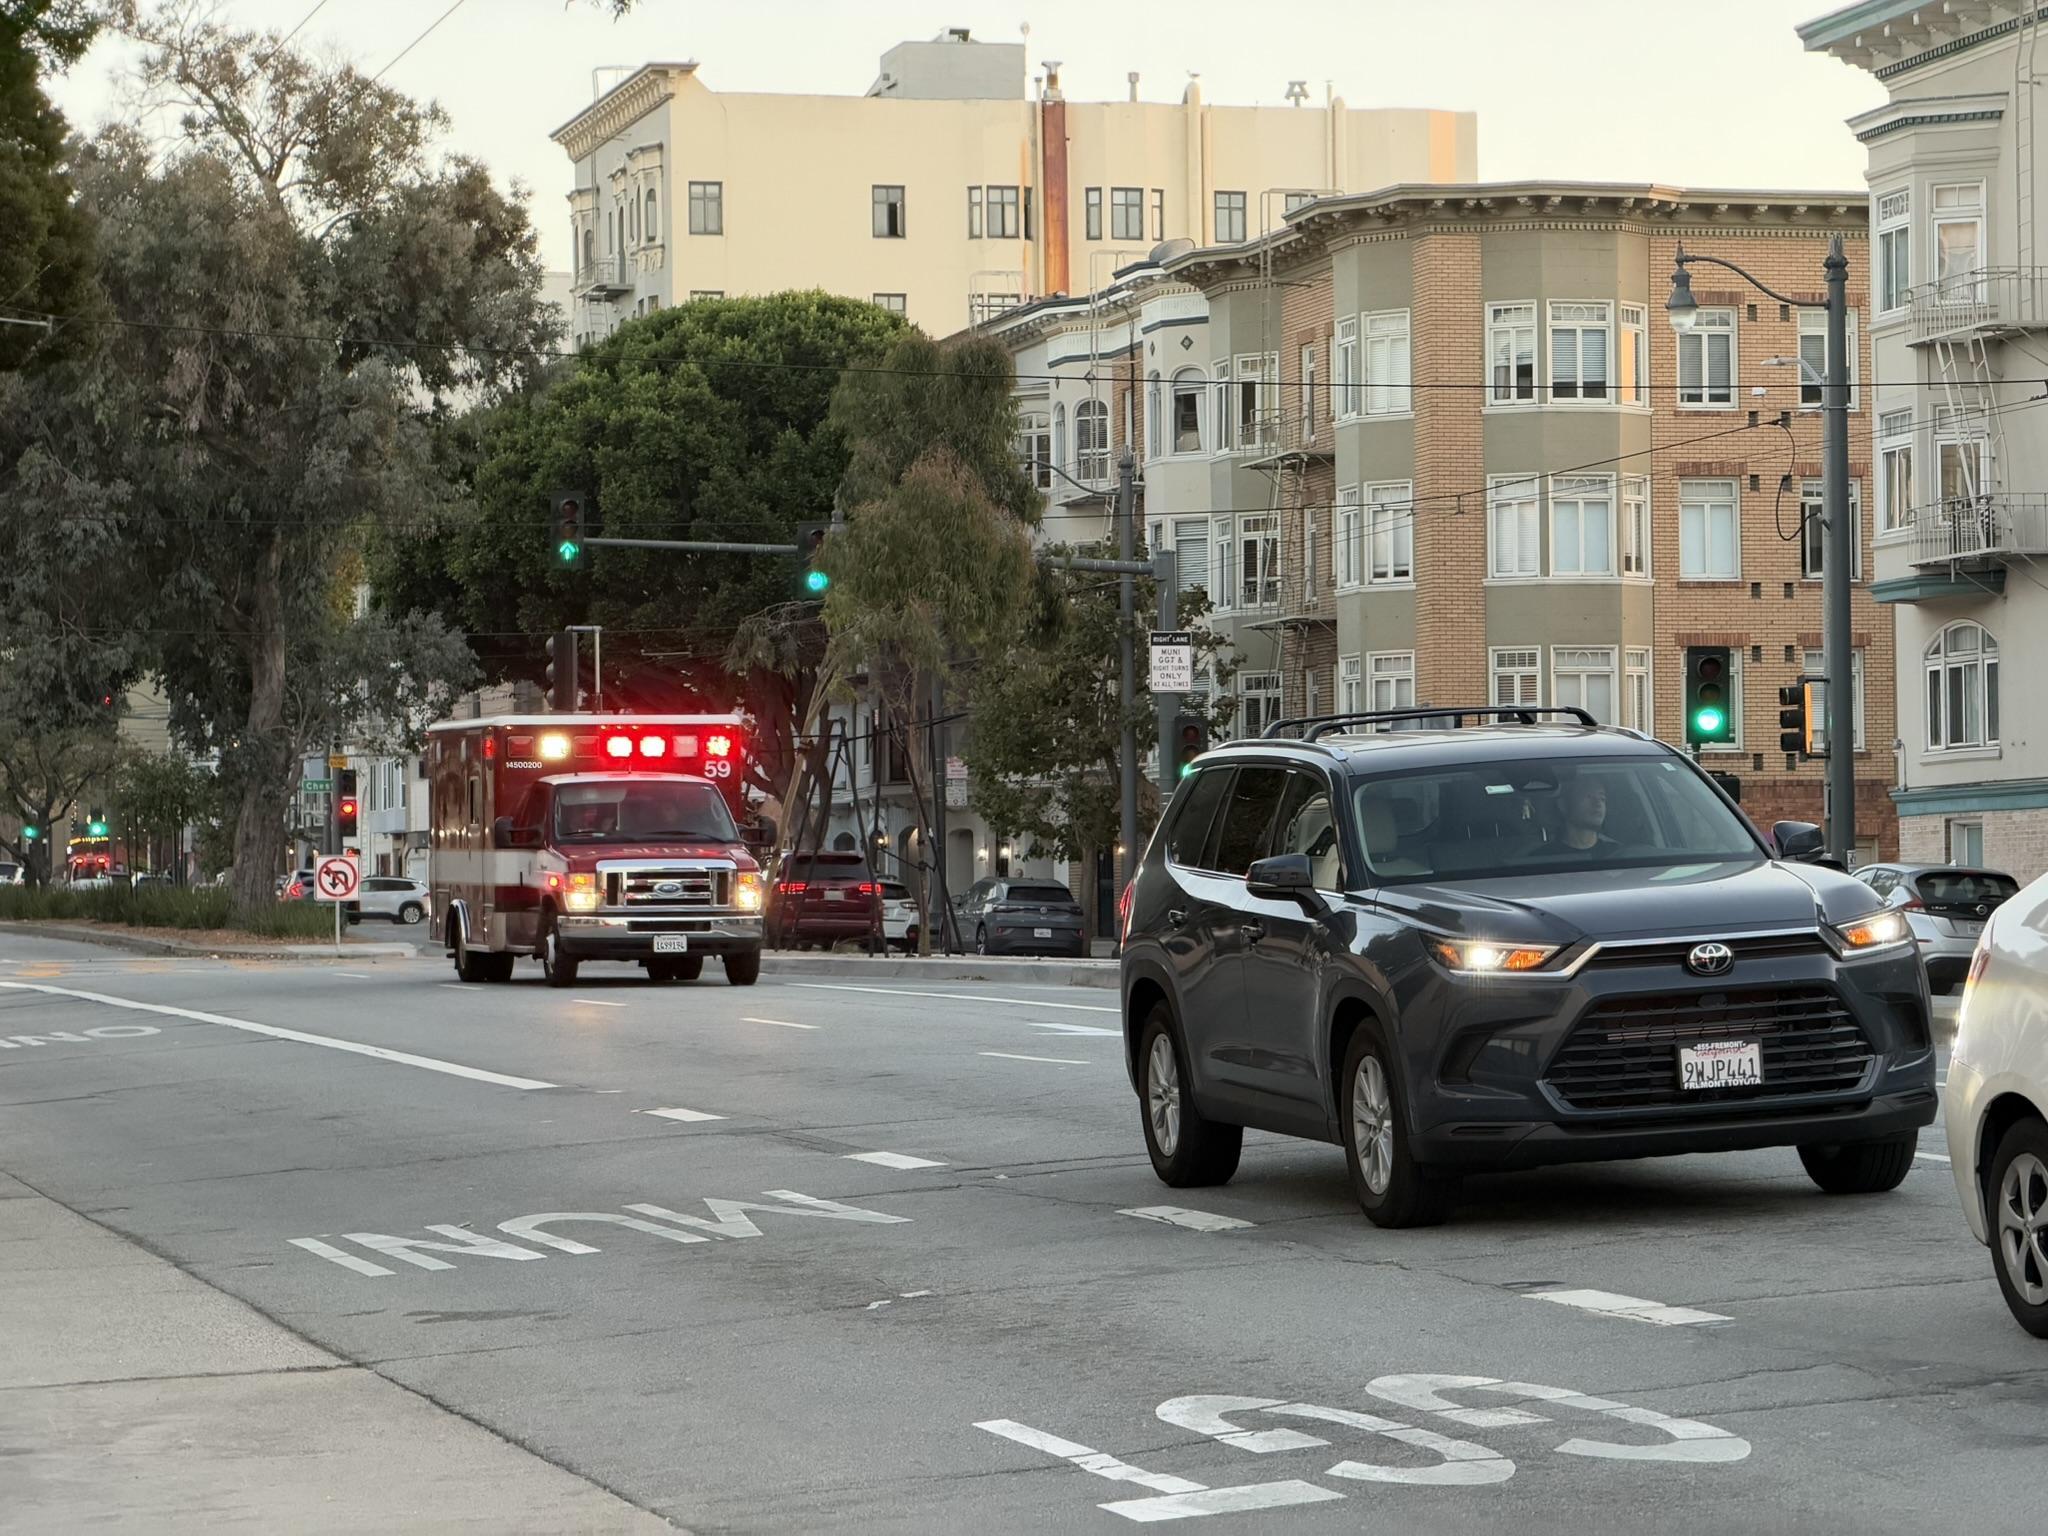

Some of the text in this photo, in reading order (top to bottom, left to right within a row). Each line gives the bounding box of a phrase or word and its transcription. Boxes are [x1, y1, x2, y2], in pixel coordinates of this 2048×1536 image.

[1161, 648, 1181, 656] MUNI
[1158, 656, 1184, 664] GGT &
[1160, 672, 1183, 680] ONLY
[506, 761, 544, 770] 14500200
[704, 760, 731, 778] 59
[1684, 1057, 1758, 1083] 9WJP441
[286, 1189, 913, 1277] MUNI
